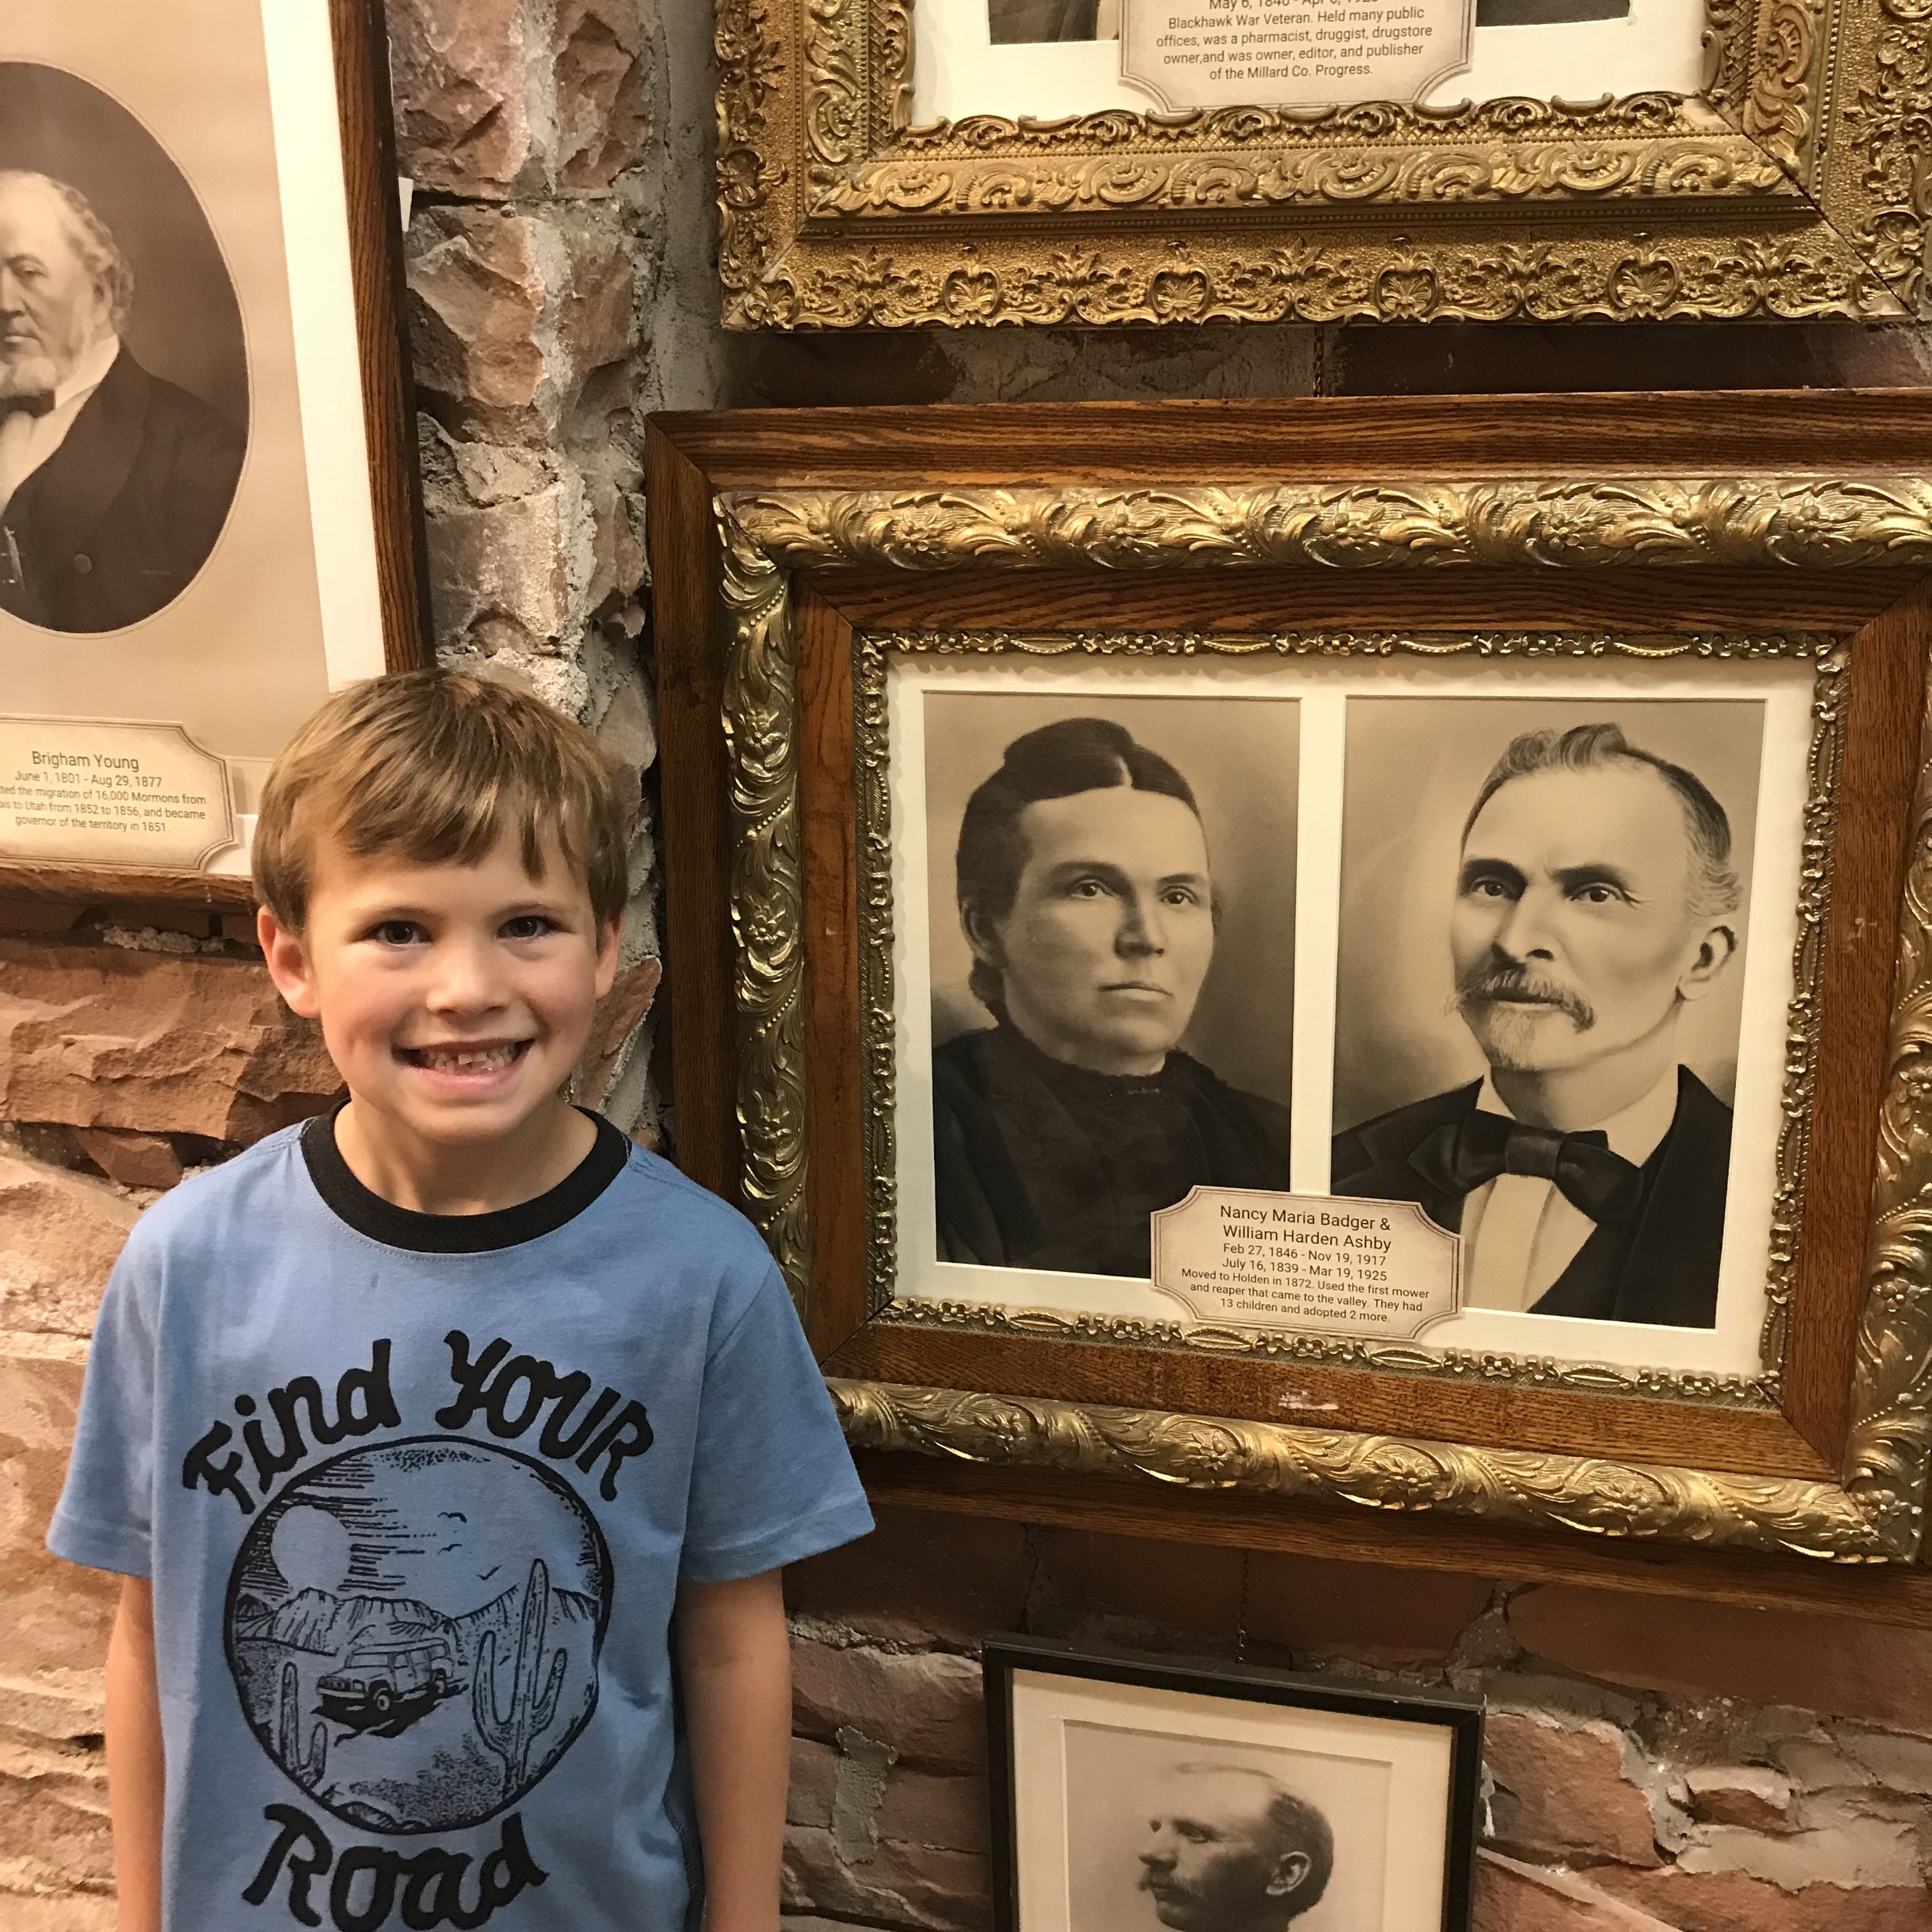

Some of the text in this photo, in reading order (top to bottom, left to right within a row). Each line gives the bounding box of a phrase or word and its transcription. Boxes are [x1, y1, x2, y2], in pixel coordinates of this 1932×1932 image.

[1169, 15, 1232, 29] Blackhawk
[1236, 13, 1260, 26] War
[1317, 10, 1346, 22] Held
[1349, 10, 1383, 23] many
[1386, 6, 1425, 22] public
[1156, 26, 1432, 47] offices, was a pharmacist, druggist, drugstore
[1228, 52, 1252, 61] was
[1255, 50, 1296, 61] owner,
[1299, 47, 1337, 59] editor,
[1340, 45, 1363, 57] and
[1366, 43, 1424, 59] publisher
[1209, 65, 1373, 80] of the Millard Co. Progress.
[32, 751, 139, 773] Brigham Young
[15, 770, 40, 781] June
[43, 772, 52, 784] 1,
[54, 772, 80, 784] 1801
[91, 774, 112, 788] Aug
[115, 775, 132, 788] 29,
[135, 776, 162, 787] 1877
[17, 786, 33, 796] the
[35, 788, 80, 799] migration
[83, 790, 93, 798] of
[95, 790, 129, 801] 16,000
[132, 792, 180, 803] Mormons
[182, 793, 206, 805] from
[13, 801, 23, 809] to
[25, 801, 47, 811] Utah
[49, 802, 72, 813] from
[74, 804, 99, 815] 1852
[101, 806, 111, 815] to
[114, 805, 141, 818] 1856,
[144, 808, 162, 817] and
[165, 808, 206, 820] became
[15, 816, 56, 826] governor
[59, 817, 69, 827] of
[71, 818, 87, 828] the
[89, 820, 128, 832] territory
[130, 821, 139, 831] in
[1220, 1205, 1391, 1231] Nancy Maria Badger &
[1223, 1225, 1392, 1254] William Harden Ashby
[1223, 1243, 1245, 1254] Feb
[1248, 1245, 1265, 1257] 27,
[1269, 1246, 1298, 1259] 1846
[1308, 1250, 1331, 1261] Nov
[1335, 1252, 1353, 1265] 19,
[1357, 1254, 1386, 1266] 1917
[1222, 1258, 1246, 1271] July
[1250, 1260, 1266, 1272] 16,
[1270, 1262, 1299, 1273] 1839
[1310, 1265, 1333, 1276] Mar
[1337, 1268, 1353, 1280] 19,
[1358, 1269, 1387, 1281] 1925
[1182, 1268, 1216, 1280] Moved
[1219, 1272, 1230, 1281] to
[1232, 1272, 1269, 1285] Holden
[1273, 1276, 1282, 1285] in
[1317, 1280, 1345, 1291] Used
[1347, 1282, 1365, 1293] the
[1368, 1284, 1388, 1295] first
[1392, 1288, 1430, 1298] mower
[1190, 1284, 1209, 1292] and
[1212, 1285, 1245, 1296] reaper
[1248, 1287, 1268, 1298] that
[1271, 1291, 1301, 1300] came
[1303, 1292, 1314, 1302] to
[1317, 1294, 1334, 1304] the
[1374, 1299, 1399, 1311] They
[1402, 1301, 1423, 1312] had
[1220, 1298, 1390, 1322] 13 children and adopted 2 more.
[182, 1337, 402, 1515] Find
[241, 1802, 551, 1932] Road
